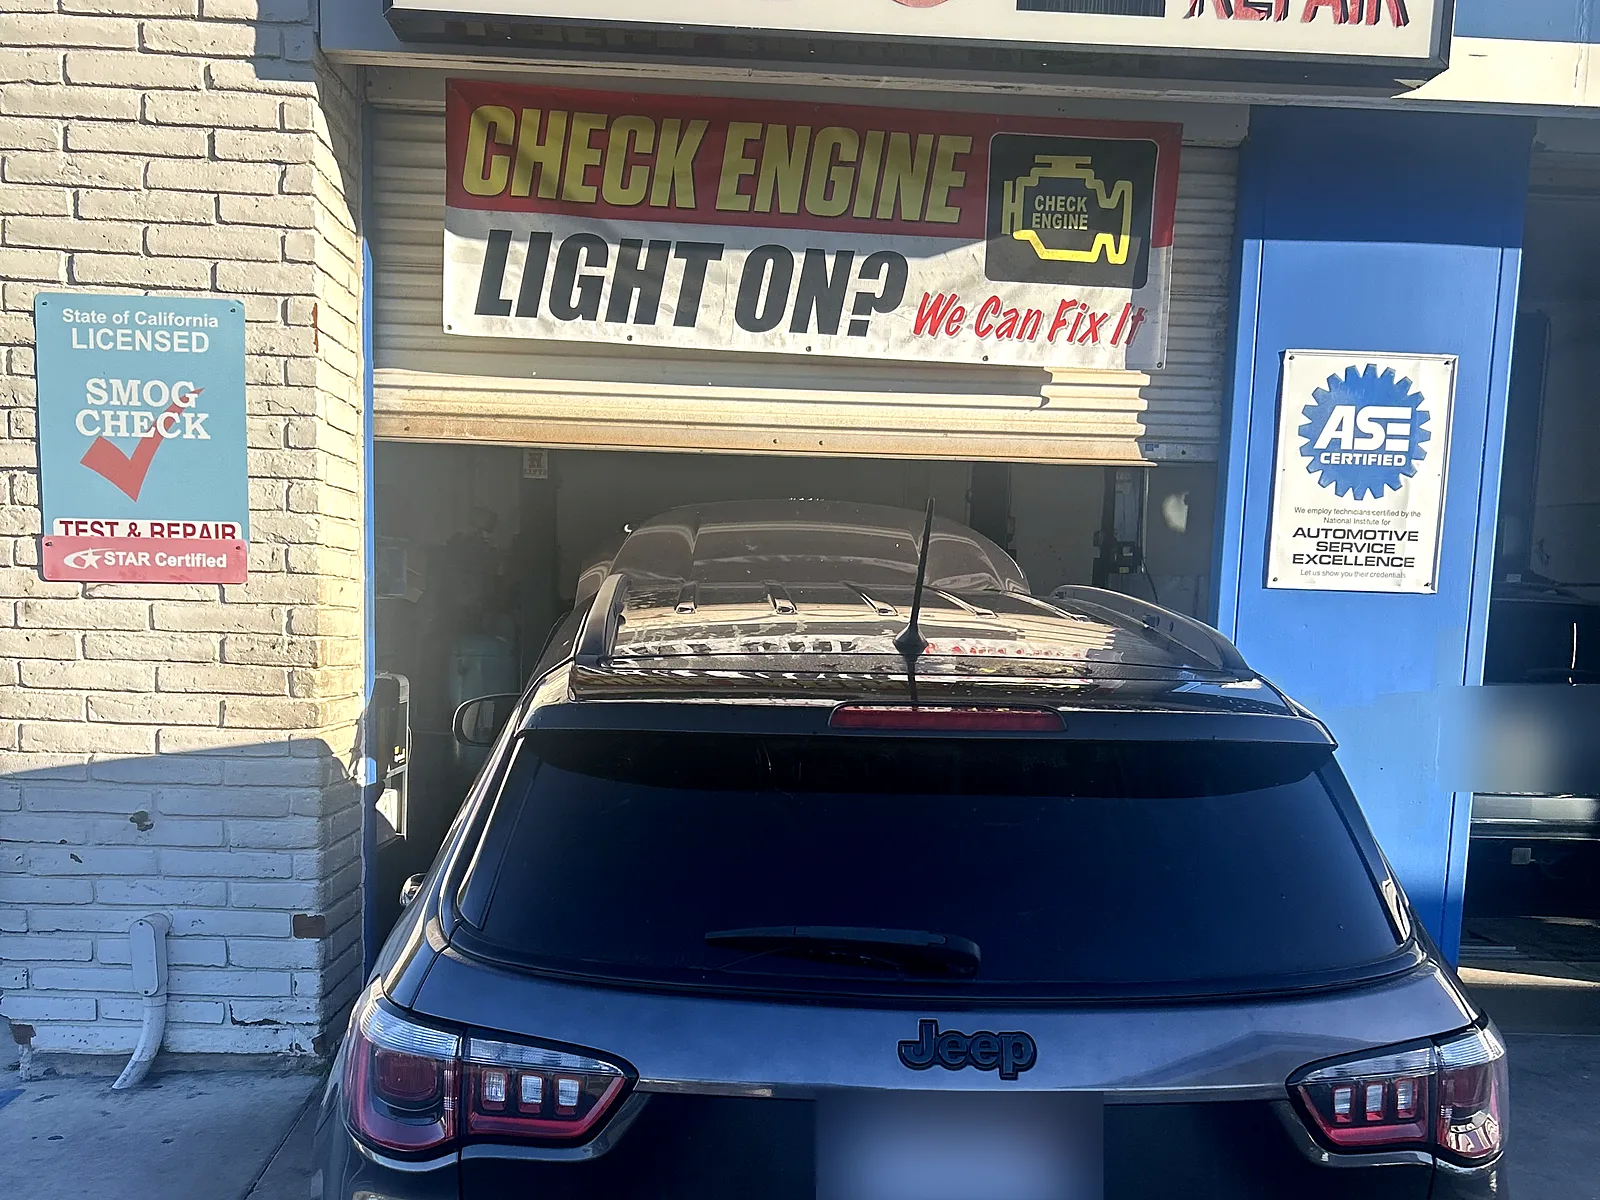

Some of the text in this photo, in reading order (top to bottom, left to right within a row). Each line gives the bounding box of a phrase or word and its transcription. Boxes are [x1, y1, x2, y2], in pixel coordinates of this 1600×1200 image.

[462, 104, 973, 224] CHECK ENGINE
[1034, 195, 1088, 212] CHECK
[1032, 212, 1088, 231] ENGINE
[474, 229, 909, 337] LIGHT ON?
[62, 308, 219, 328] State of California
[913, 291, 1148, 346] We Can Fix It
[71, 327, 210, 353] LICENSED
[86, 378, 199, 408] SMOG
[75, 410, 211, 440] CHECK
[1313, 405, 1412, 452] ASE
[1320, 452, 1406, 466] CERTIFIED
[1307, 508, 1332, 516] employ
[1333, 508, 1371, 516] technicians
[1372, 509, 1399, 517] certified
[1401, 510, 1409, 518] by
[1292, 527, 1419, 541] AUTOMOTIVE
[1315, 541, 1396, 554] SERVICE
[104, 552, 227, 568] STAR Certified
[1292, 553, 1415, 568] EXCELLENCE
[898, 1018, 1037, 1081] Jeep
